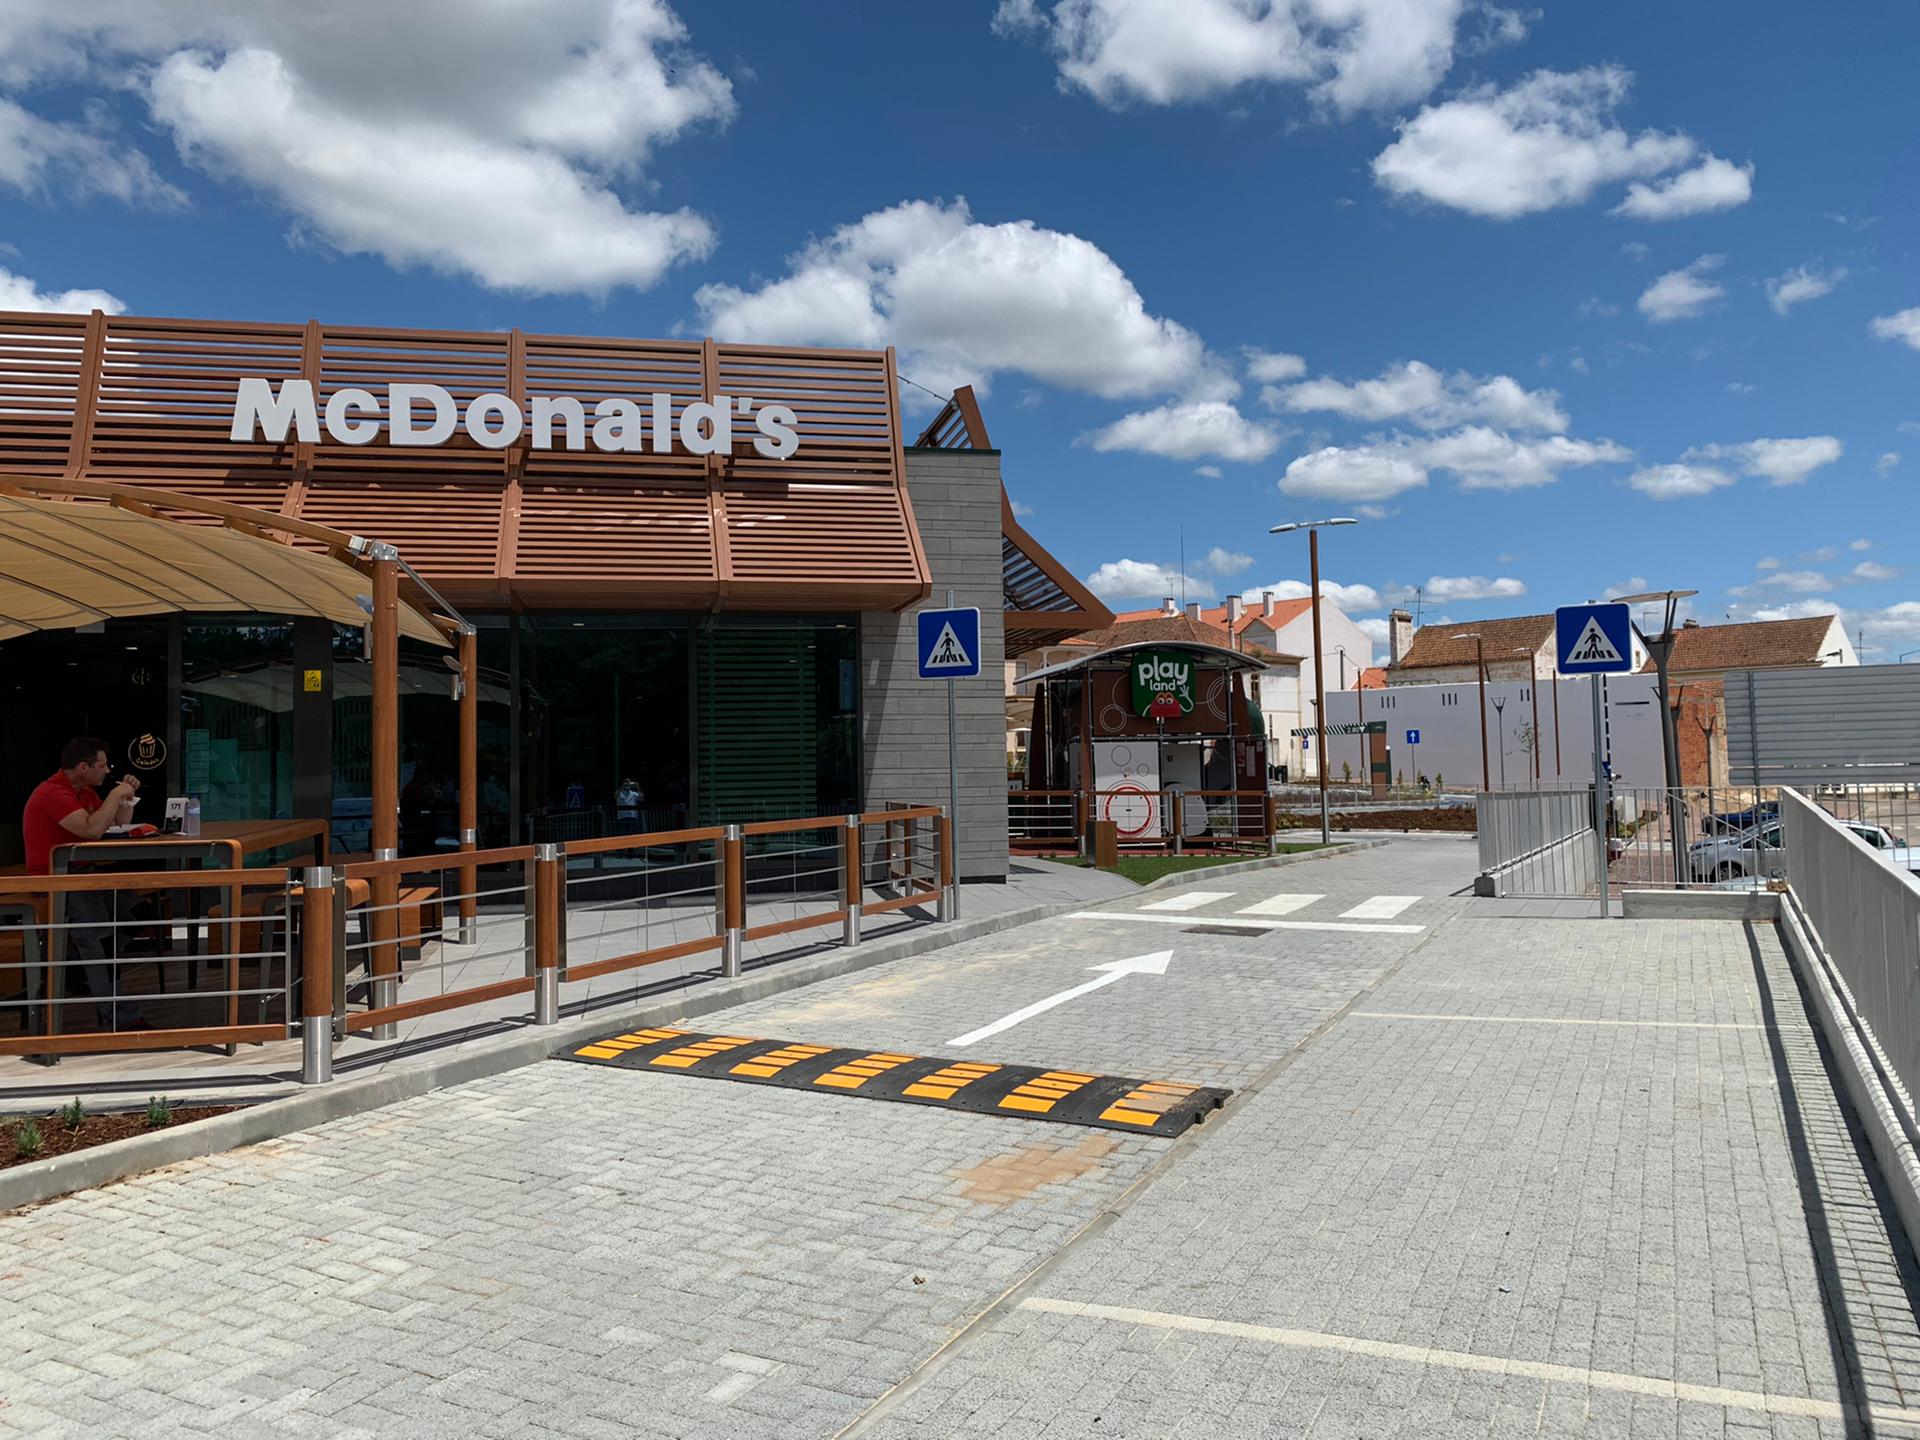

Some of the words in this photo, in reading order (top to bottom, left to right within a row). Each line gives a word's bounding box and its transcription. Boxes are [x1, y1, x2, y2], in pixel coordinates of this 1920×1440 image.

[230, 378, 800, 459] McDonald's
[1138, 655, 1189, 686] play
[1149, 679, 1176, 691] land
